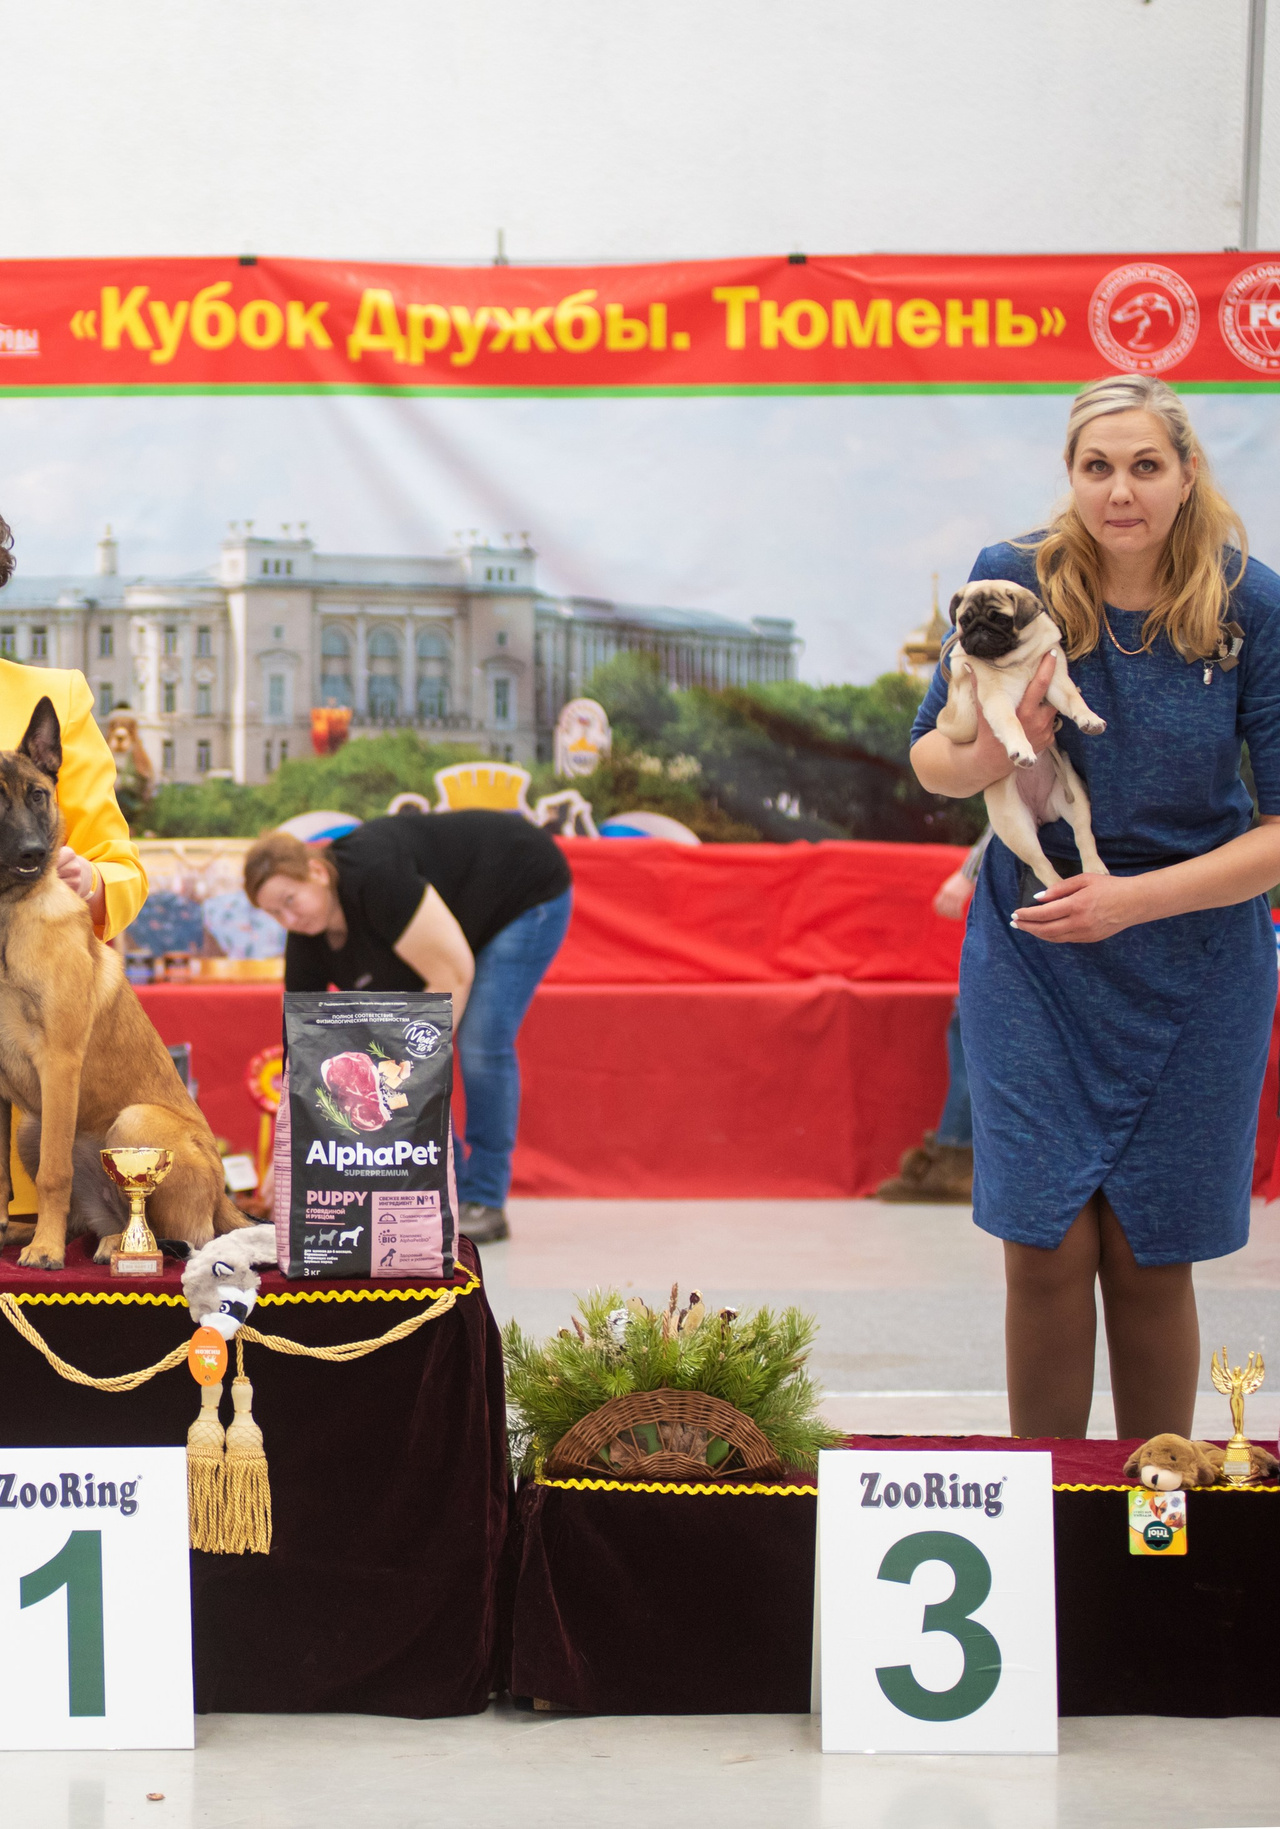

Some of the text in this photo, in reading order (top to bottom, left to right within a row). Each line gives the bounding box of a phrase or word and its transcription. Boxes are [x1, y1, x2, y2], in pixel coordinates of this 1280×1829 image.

[69, 281, 1068, 367] «Кубок Дружбы. Тюмень»
[1249, 303, 1280, 329] FC
[305, 1140, 439, 1171] AlphaPet
[344, 1169, 409, 1177] SUPERPREMIUM
[306, 1190, 368, 1206] PUPPY
[304, 1267, 310, 1276] 3
[860, 1472, 1005, 1518] ZooRing
[1147, 1529, 1170, 1538] Triol
[19, 1529, 106, 1717] 1
[875, 1530, 1003, 1722] 3
